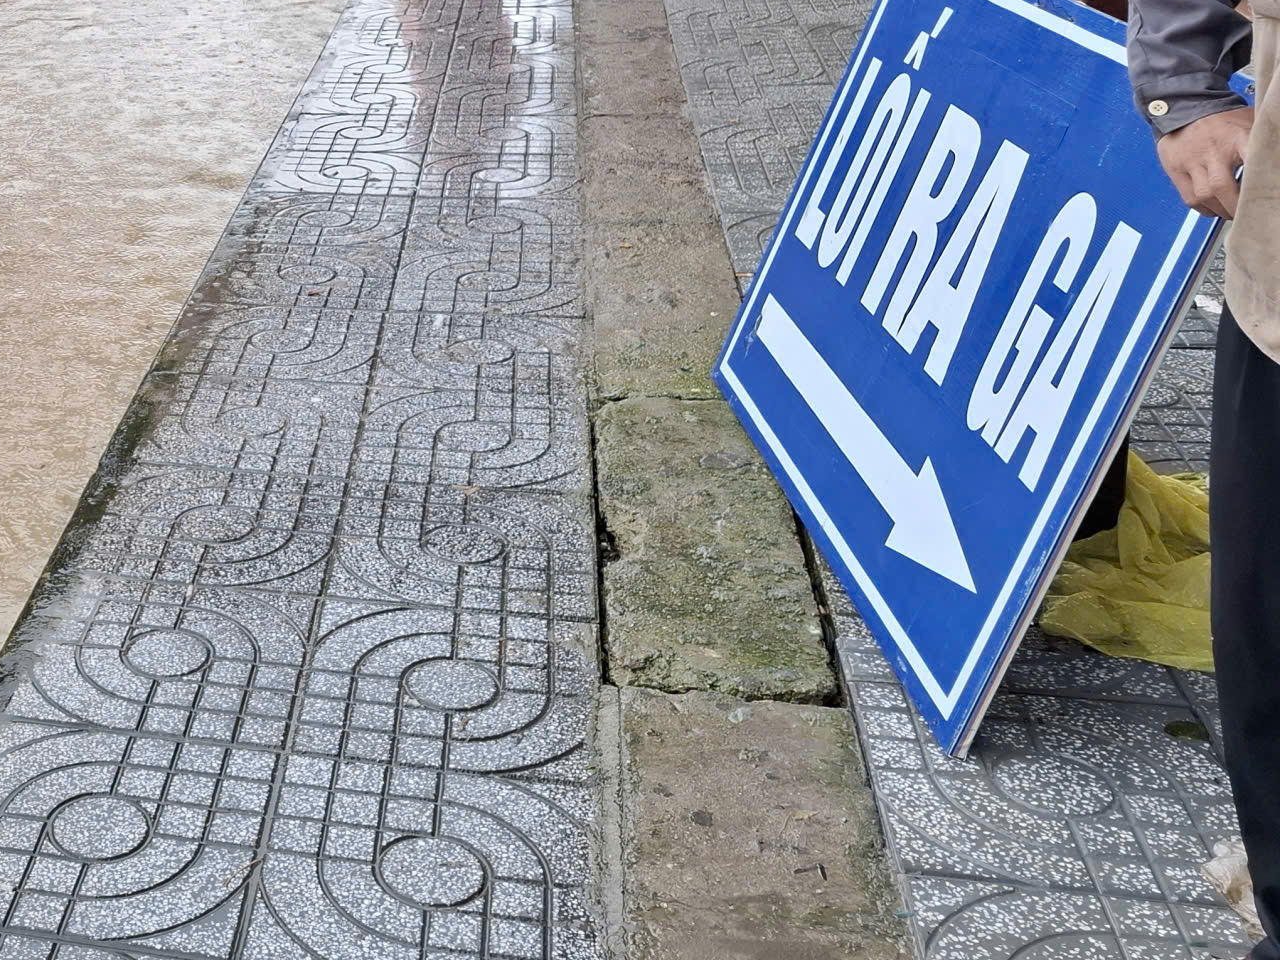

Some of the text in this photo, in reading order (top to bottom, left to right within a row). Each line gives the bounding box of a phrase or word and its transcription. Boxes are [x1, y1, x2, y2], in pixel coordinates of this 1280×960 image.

[795, 6, 1142, 493] LỐI RA GA
